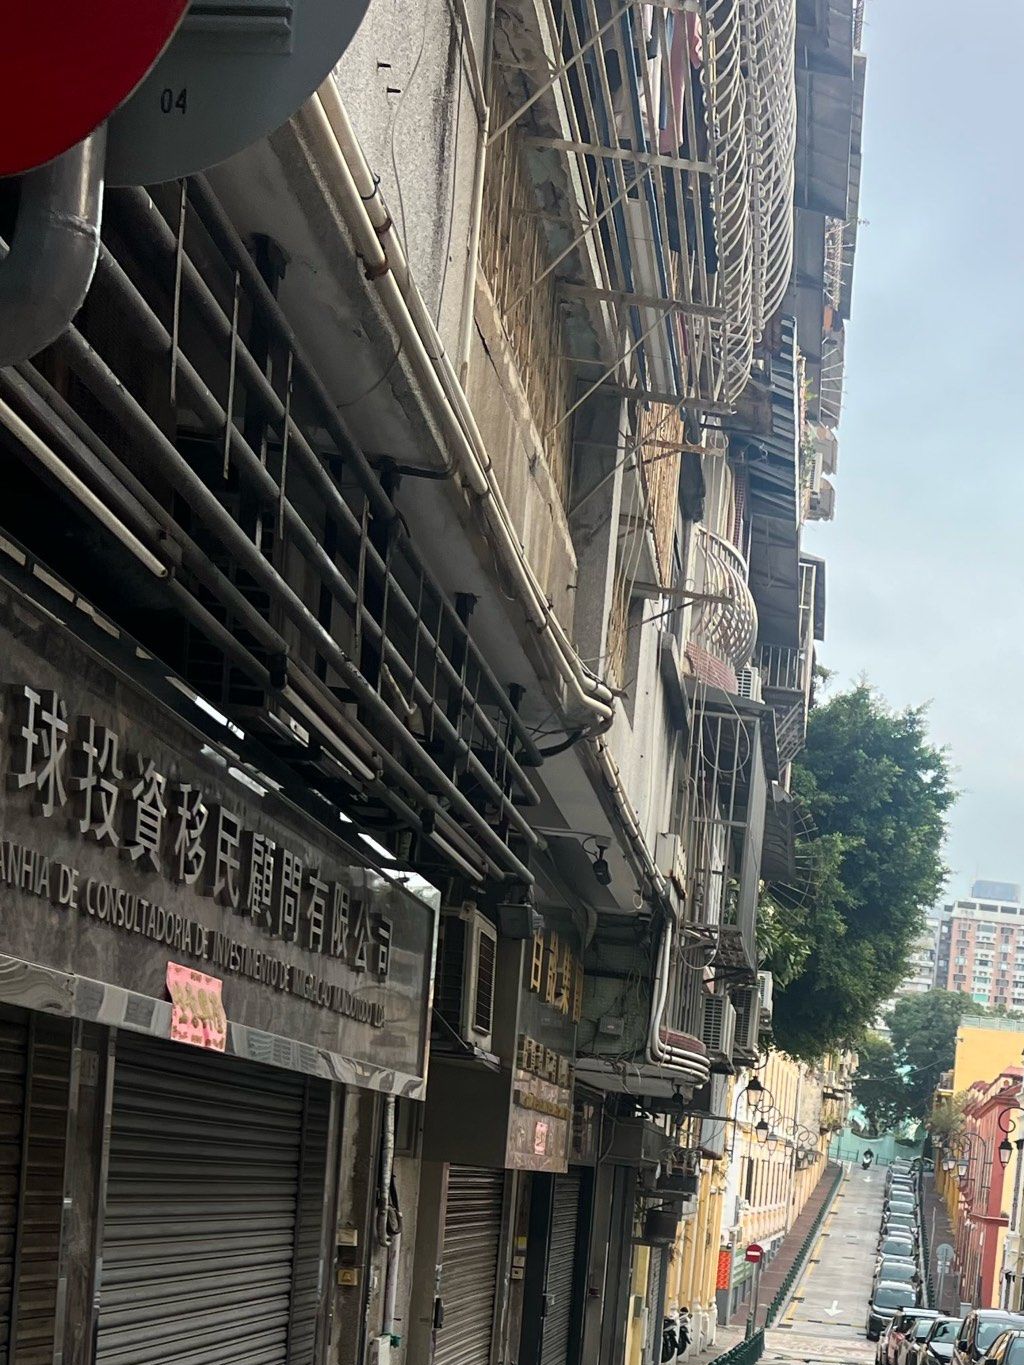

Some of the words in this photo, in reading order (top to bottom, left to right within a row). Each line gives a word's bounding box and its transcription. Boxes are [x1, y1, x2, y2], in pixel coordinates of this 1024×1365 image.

[160, 87, 187, 115] 04
[17, 685, 393, 976] 球投資移民顧問有限公司
[58, 863, 80, 909] DE
[86, 877, 192, 953] CONSULTADORIA
[195, 922, 209, 959] DE
